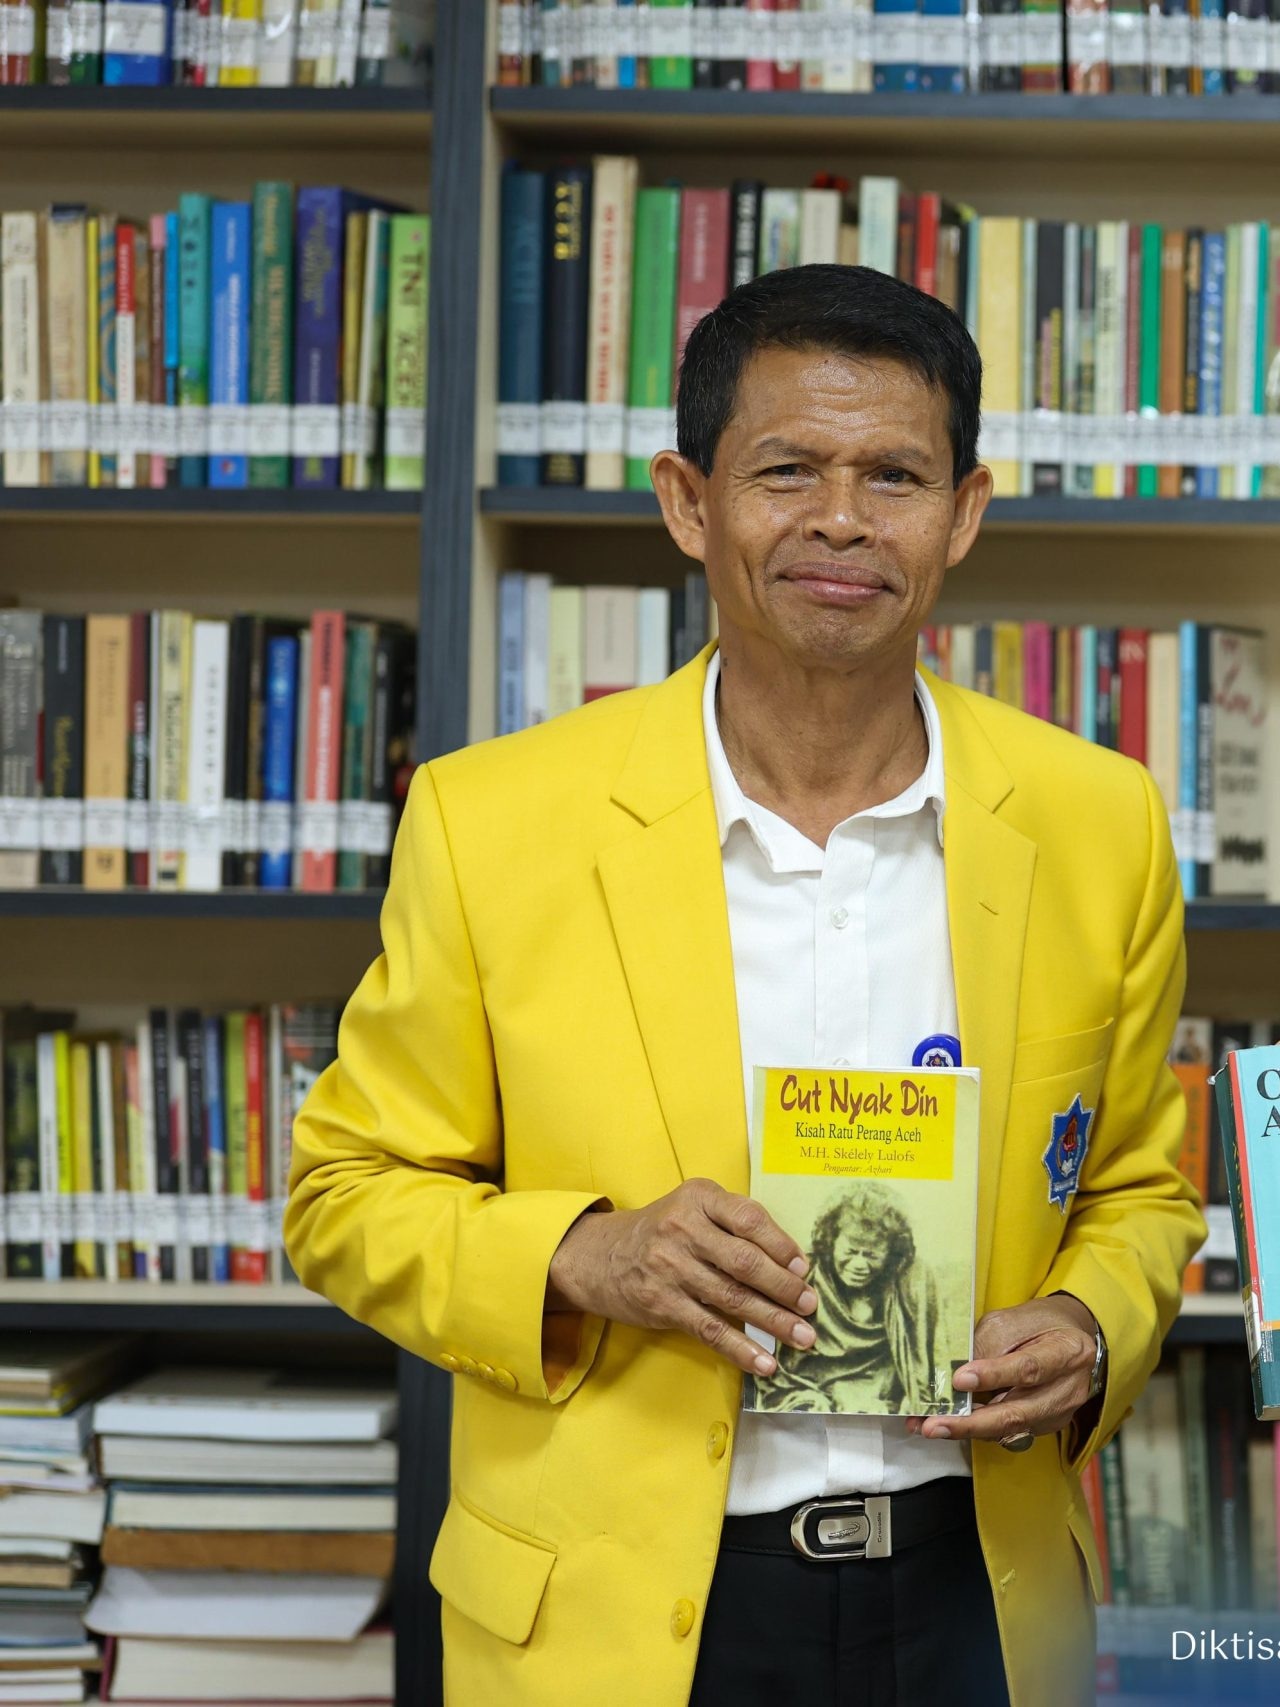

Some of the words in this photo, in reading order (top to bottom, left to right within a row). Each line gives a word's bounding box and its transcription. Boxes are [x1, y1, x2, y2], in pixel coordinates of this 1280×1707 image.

[780, 1075, 822, 1114] Cut
[829, 1077, 893, 1125] Nyak
[900, 1079, 938, 1117] Din
[795, 1121, 825, 1139] Kisah
[828, 1122, 853, 1140] Ratu
[856, 1124, 892, 1144] Perang
[894, 1126, 921, 1143] Aceh
[800, 1145, 830, 1159] M.H.
[878, 1149, 916, 1163] Lulofs
